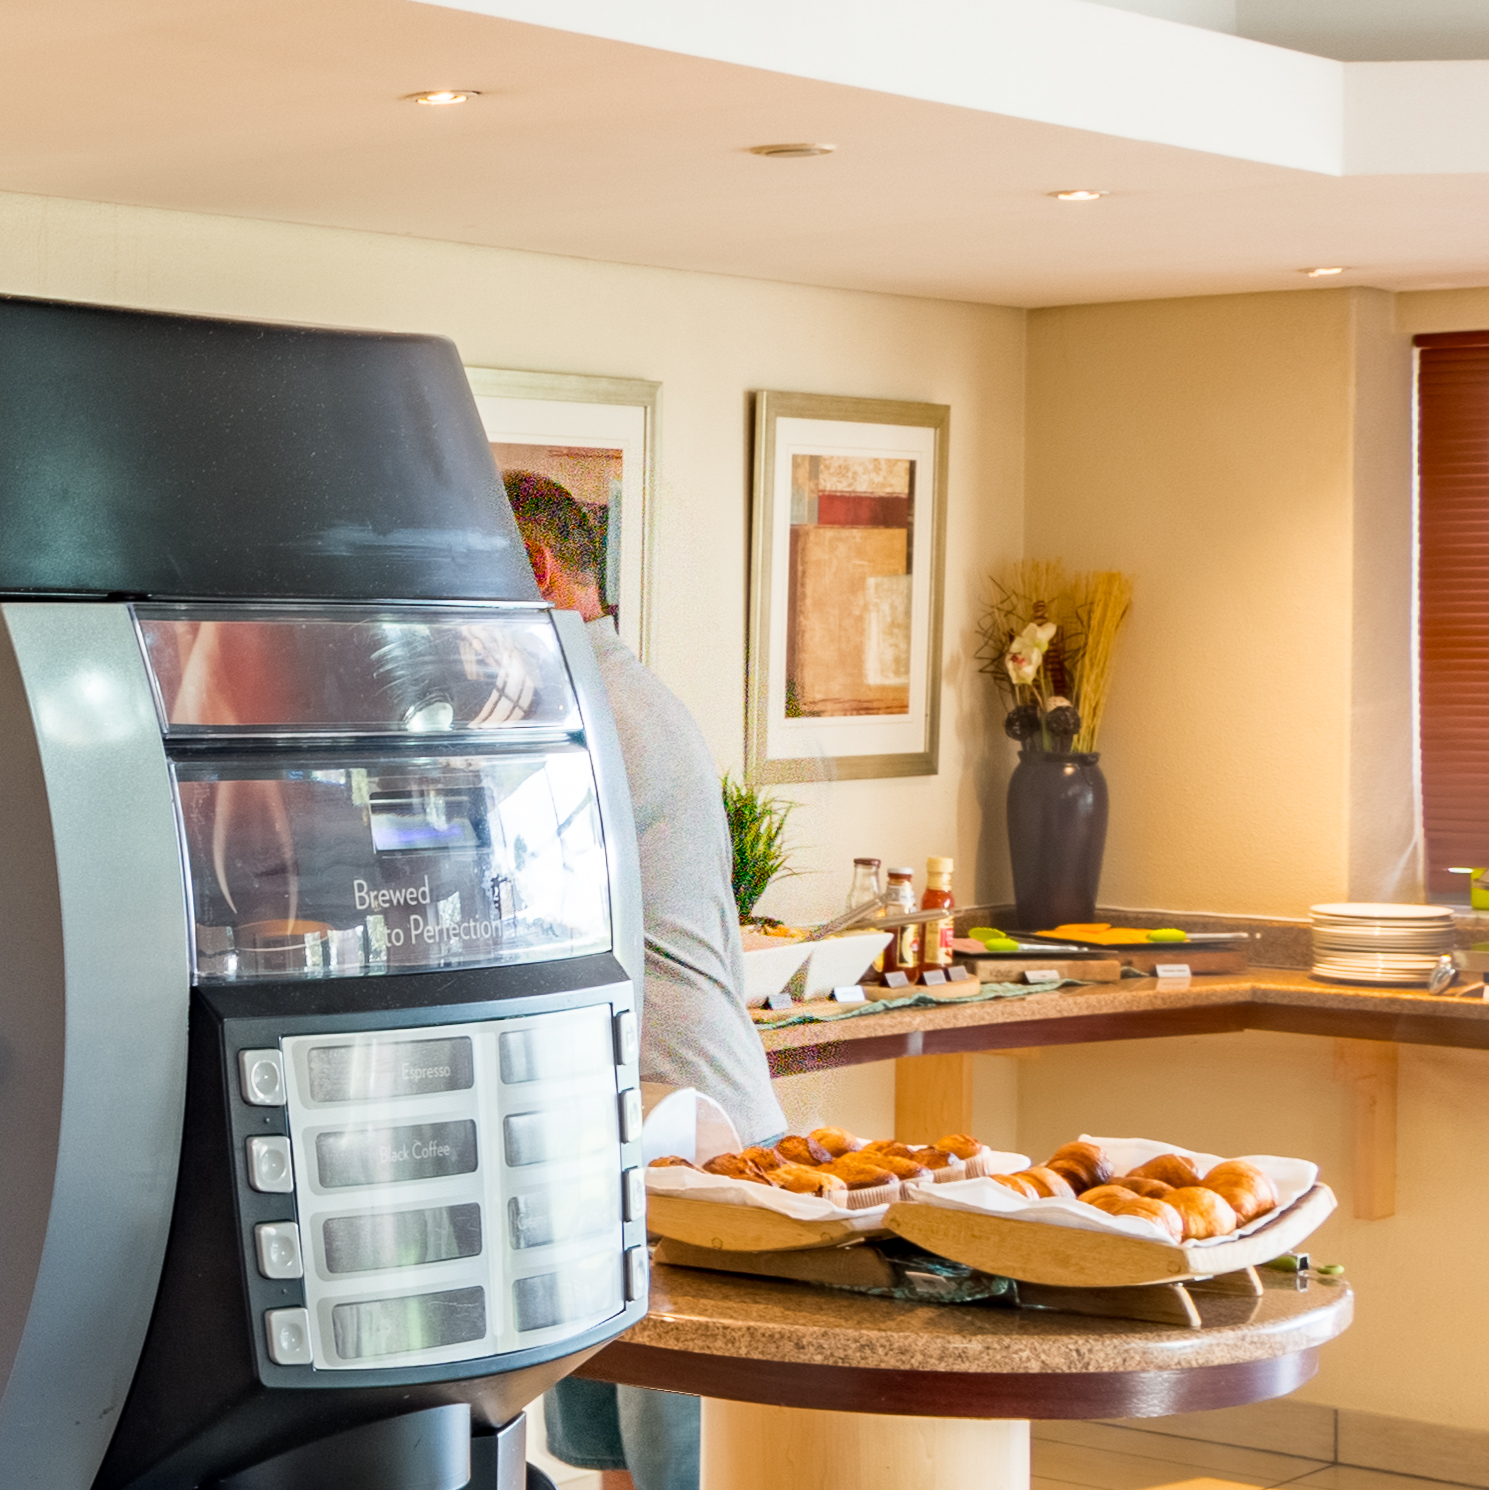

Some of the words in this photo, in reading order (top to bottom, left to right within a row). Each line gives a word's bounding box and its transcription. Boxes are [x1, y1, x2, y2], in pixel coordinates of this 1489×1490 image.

[353, 874, 431, 910] Brewed
[385, 924, 405, 947] to
[409, 914, 502, 945] Perfection
[401, 1062, 451, 1082] Espresso
[380, 1143, 410, 1163] Black
[411, 1140, 451, 1159] Coffee
